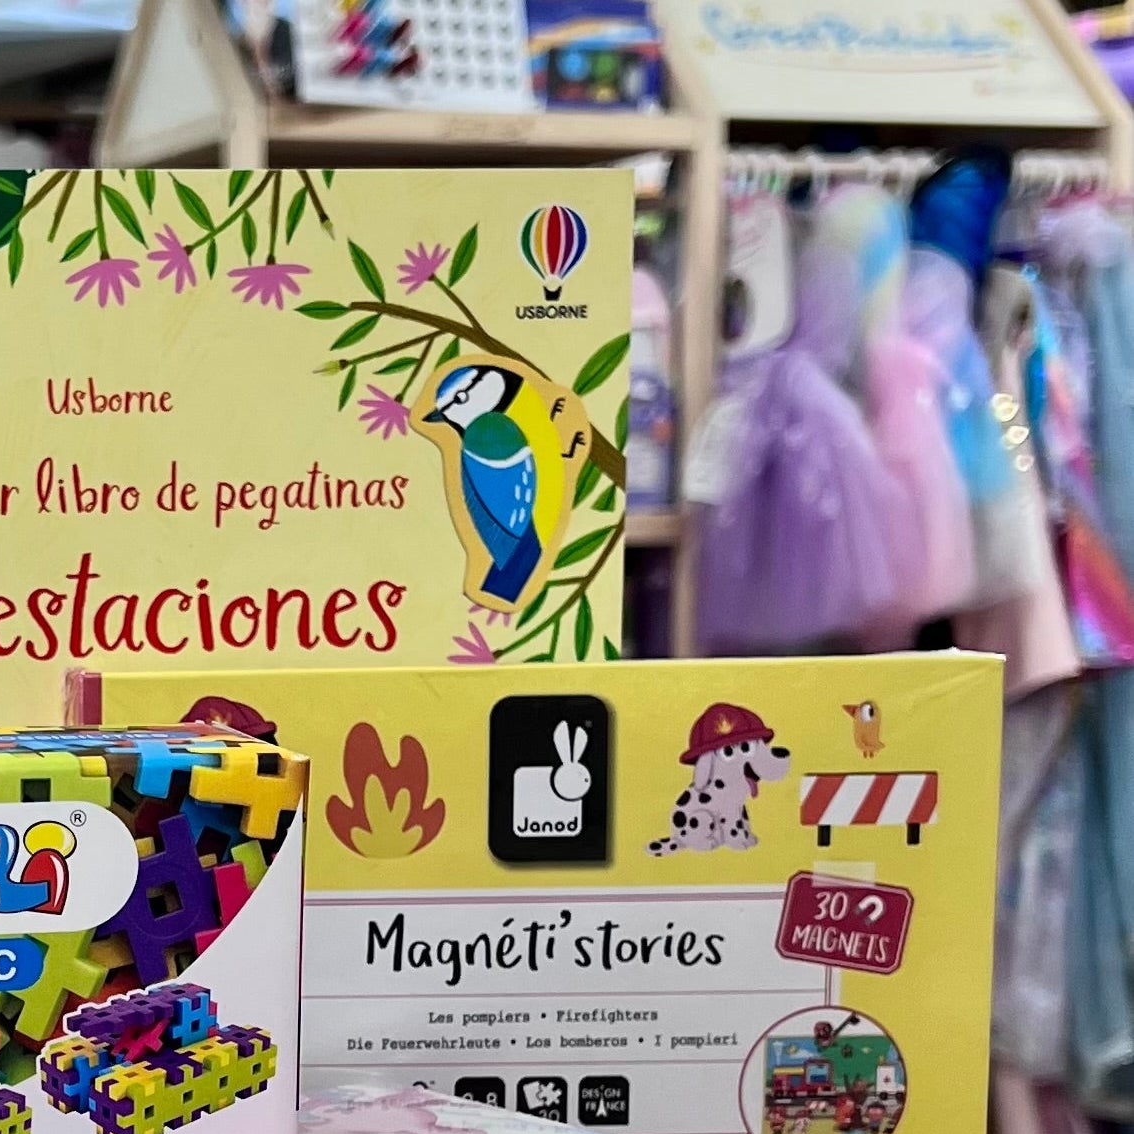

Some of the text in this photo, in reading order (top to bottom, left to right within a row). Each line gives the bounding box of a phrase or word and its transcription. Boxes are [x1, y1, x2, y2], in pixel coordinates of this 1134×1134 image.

[516, 305, 588, 320] USBORNE
[46, 377, 175, 416] Usborne
[36, 456, 141, 517] libro
[156, 460, 199, 513] de
[214, 461, 409, 531] pegatinas
[517, 816, 578, 833] Janod
[814, 891, 849, 921] 30
[366, 911, 725, 987] Magnéti'stories
[791, 924, 890, 963] MAGNETS
[428, 1009, 659, 1026] Les pompiers Firefighters
[347, 1034, 738, 1051] Die Feuerwehrleute Los bomberos I pompieri
